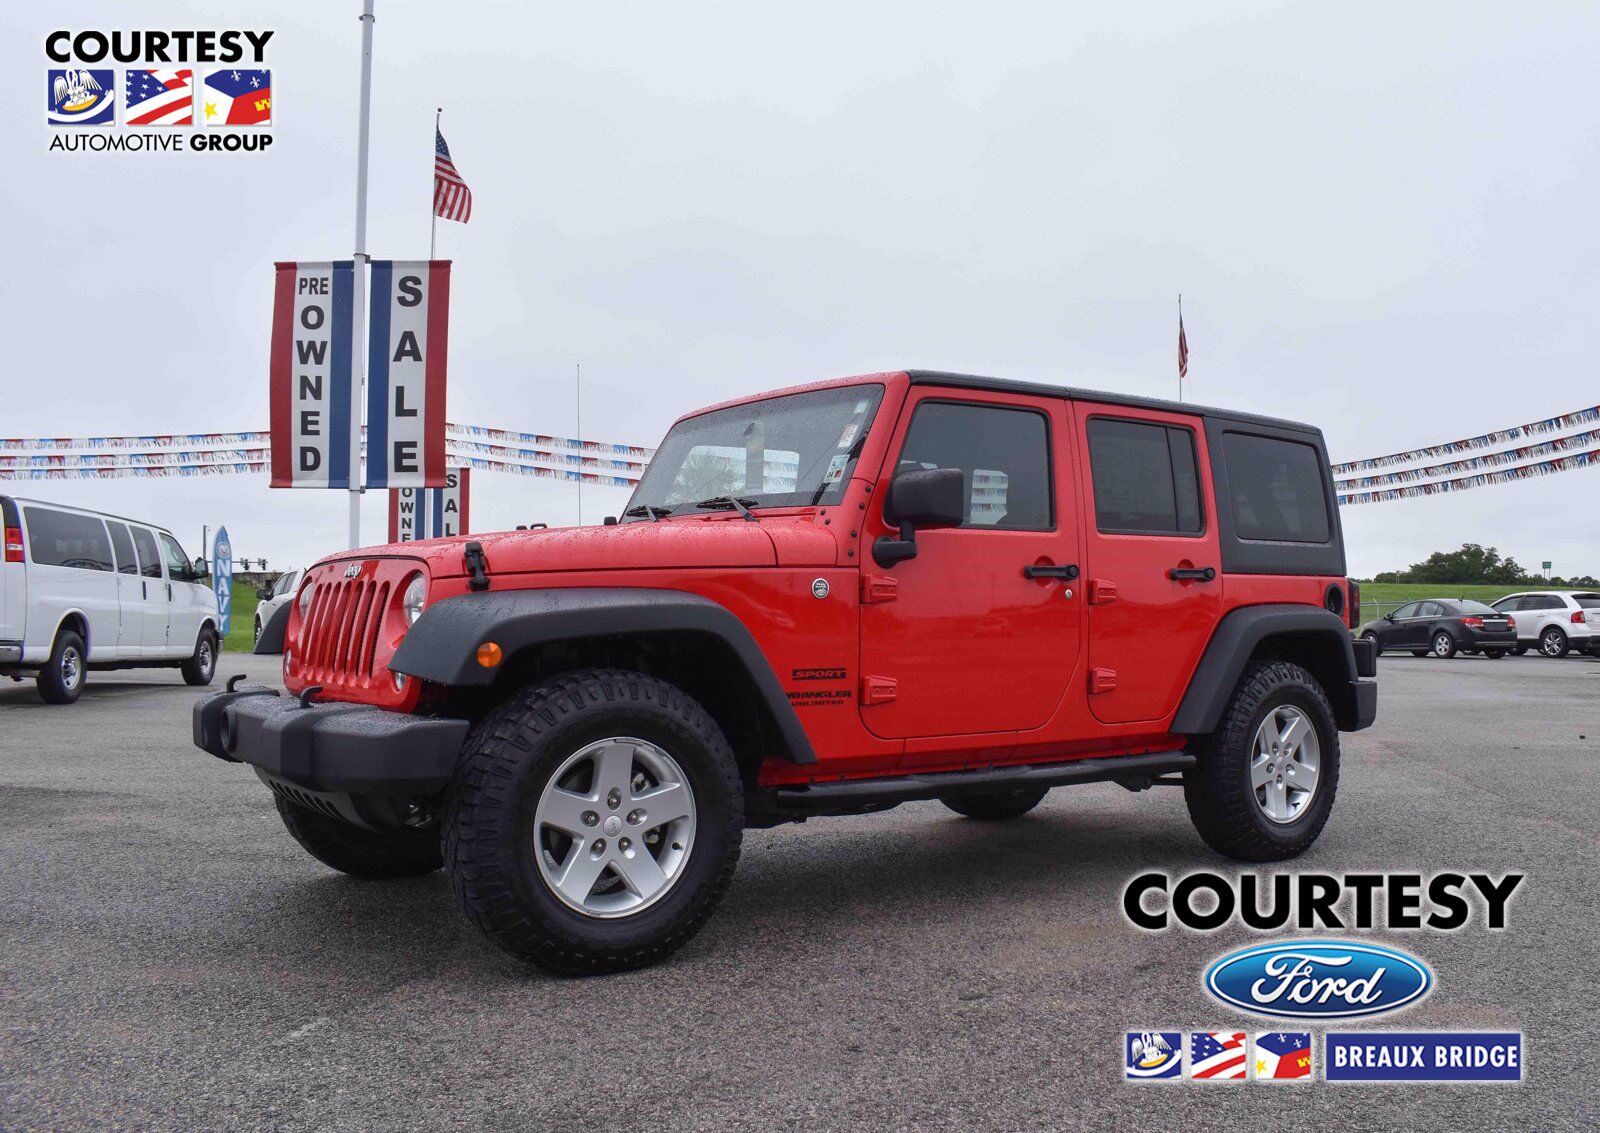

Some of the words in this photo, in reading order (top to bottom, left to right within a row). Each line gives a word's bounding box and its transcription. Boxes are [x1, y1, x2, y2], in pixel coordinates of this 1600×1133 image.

[299, 277, 329, 295] PRE
[296, 305, 328, 472] OWNED
[392, 275, 423, 473] SALE
[400, 487, 414, 542] OWNE
[444, 474, 458, 537] SAL
[216, 559, 231, 631] NAVY
[793, 669, 847, 680] SPORT
